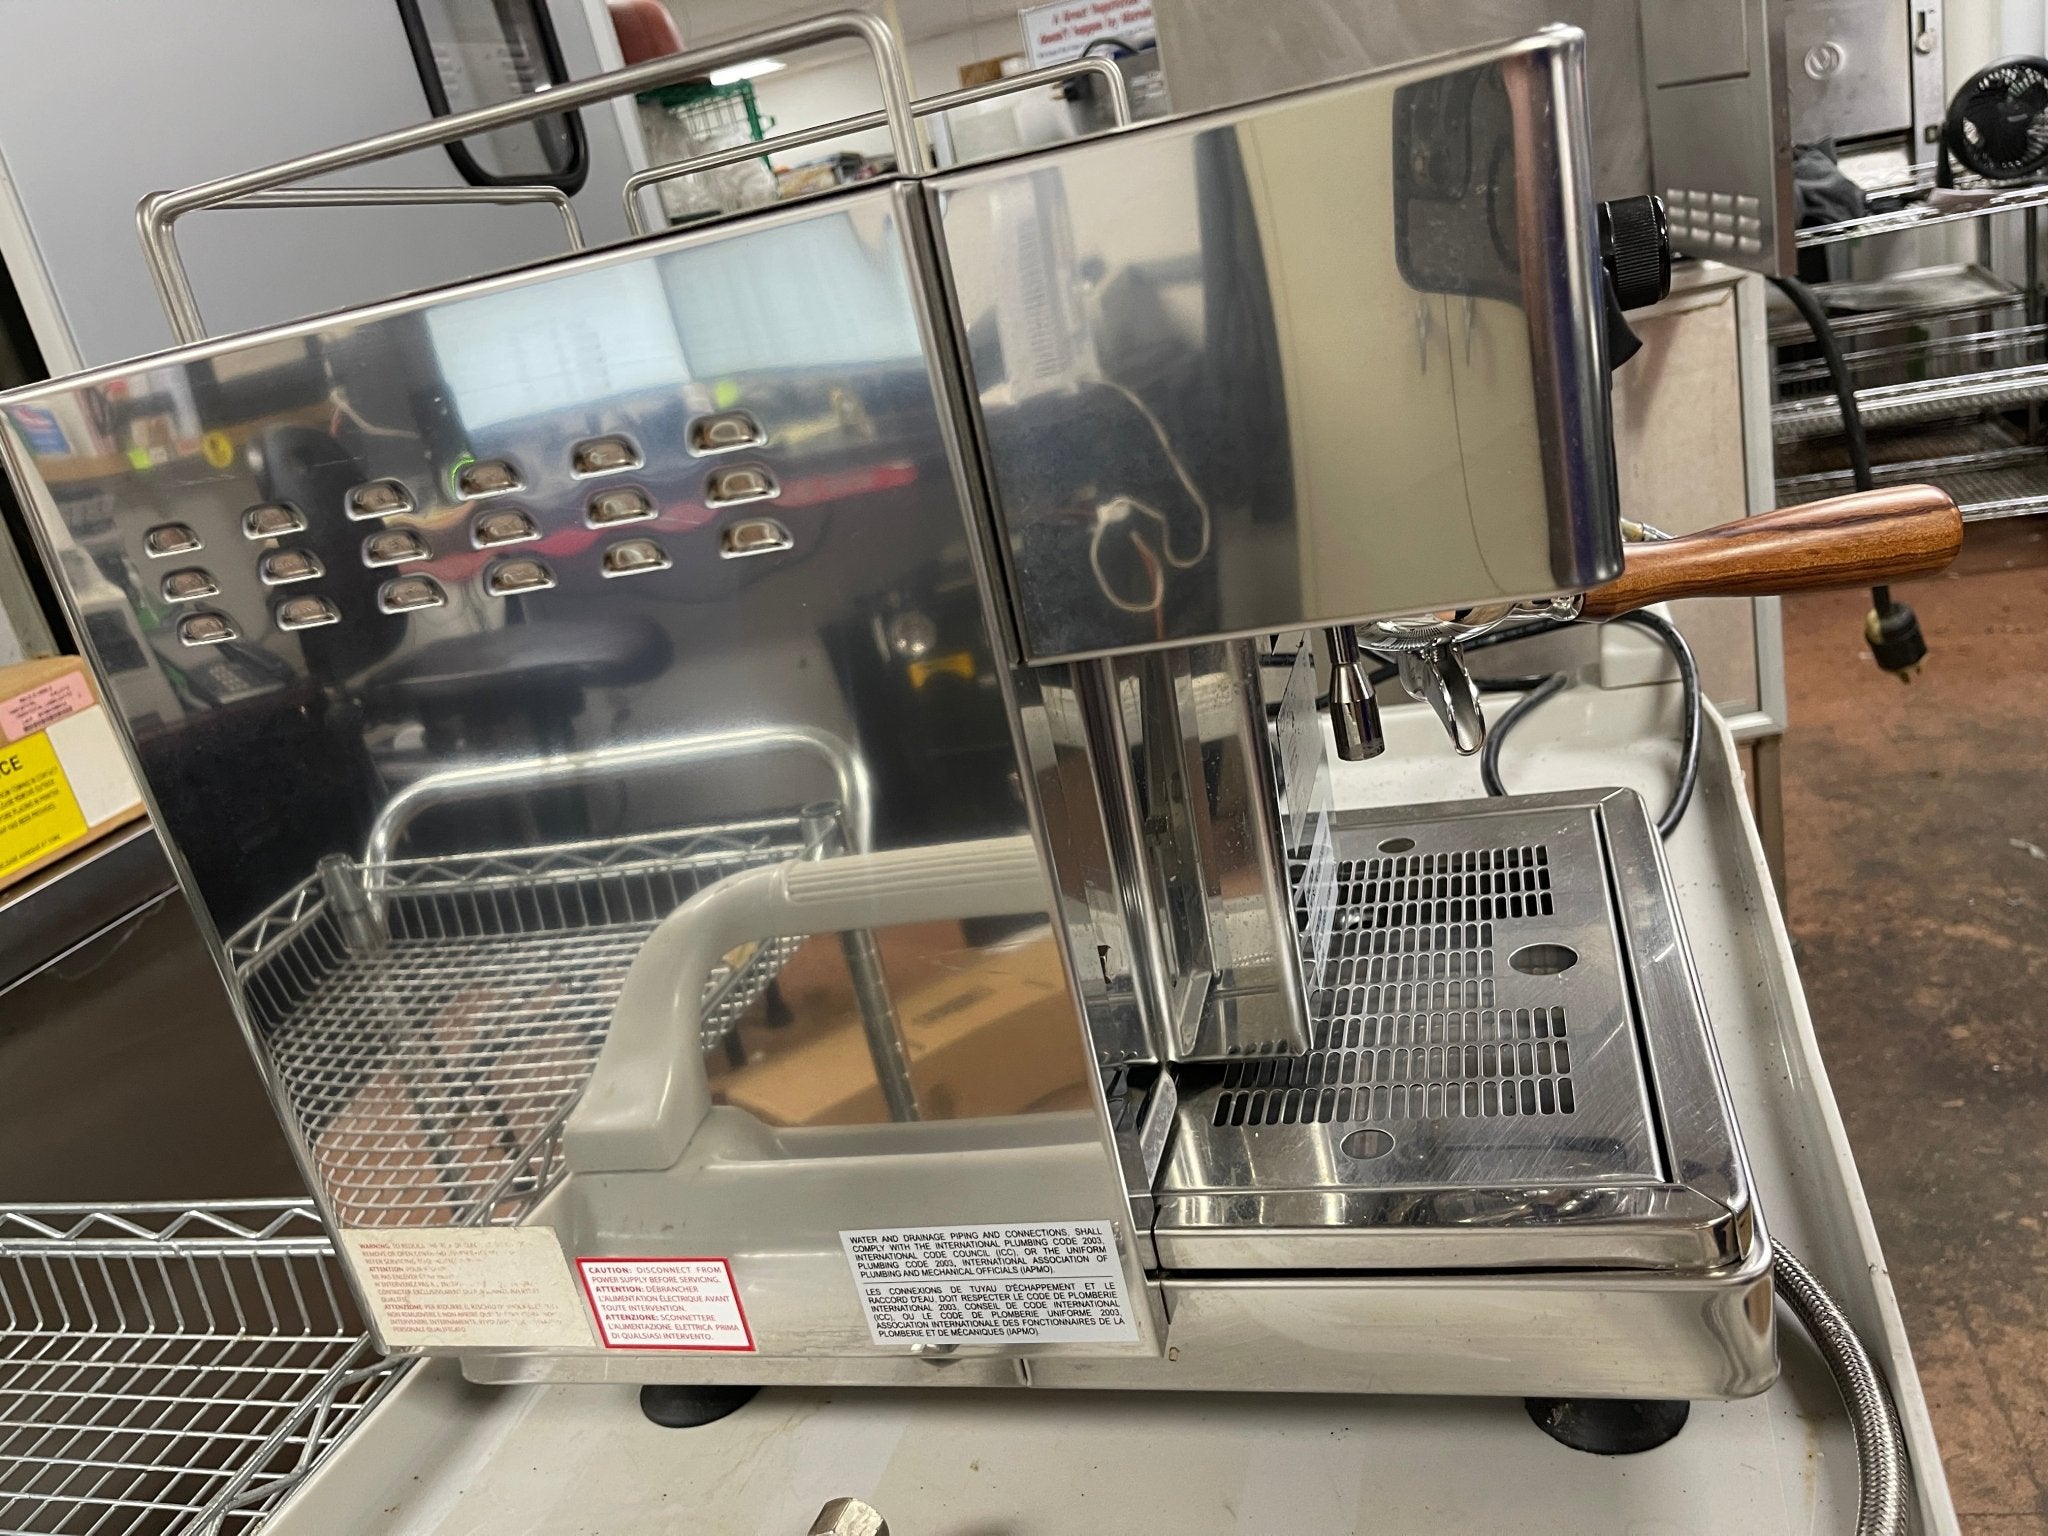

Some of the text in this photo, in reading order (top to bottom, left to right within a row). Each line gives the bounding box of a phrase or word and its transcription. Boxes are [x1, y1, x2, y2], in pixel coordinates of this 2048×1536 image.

[850, 1236, 878, 1244] WATER
[882, 1235, 899, 1243] AND
[903, 1233, 946, 1242] DRAINAGE
[950, 1232, 979, 1240] PIPING
[983, 1231, 1000, 1239] AND
[1075, 1227, 1103, 1236] SHALL
[852, 1244, 885, 1253] COMPLY
[936, 1240, 1000, 1249] INTERNATIONAL
[1004, 1238, 1048, 1247] PLUMBING
[855, 1252, 918, 1261] INTERNATIONAL
[923, 1251, 947, 1259] CODE
[953, 1249, 990, 1258] COUNCIL
[1044, 1247, 1060, 1255] THE
[1066, 1246, 1106, 1254] UNIFORM
[858, 1261, 899, 1270] PLUMBING
[905, 1260, 929, 1268] CODE
[962, 1257, 1027, 1266] INTERNATIONAL
[1033, 1255, 1089, 1264] ASSOCIATION
[860, 1270, 902, 1278] PLUMBING
[903, 1269, 920, 1277] AND
[922, 1267, 976, 1276] MECHANICAL
[975, 1266, 1019, 1274] OFFICIALS
[889, 1287, 942, 1295] CONNEXIONS
[970, 1285, 998, 1293] TUYAU
[1005, 1283, 1076, 1292] D'ÉCHAPPEMENT
[1085, 1282, 1095, 1290] ET
[1104, 1282, 1116, 1290] LE
[868, 1296, 908, 1304] RACCORD
[939, 1294, 958, 1302] DOIT
[961, 1293, 1011, 1301] RESPECTER
[1026, 1292, 1051, 1300] CODE
[1068, 1291, 1118, 1299] PLOMBERIE
[871, 1304, 933, 1312] INTERNATIONAL
[965, 1302, 1001, 1310] CONSEIL
[1005, 1302, 1018, 1310] DE
[1024, 1301, 1048, 1309] CODE
[1054, 1300, 1121, 1308] INTERNATIONAL
[922, 1312, 933, 1320] LE
[940, 1312, 964, 1320] CODE
[972, 1311, 984, 1319] DE
[991, 1310, 1040, 1318] PLOMBERIE
[1047, 1309, 1092, 1317] UNIFORME
[876, 1317, 1125, 1329] ASSOCIATION INTERNATIONALE DES FONCTIONNAIRES DE LA
[879, 1329, 924, 1338] PLOMBERIE
[951, 1328, 1005, 1336] MÉCANIQUES
